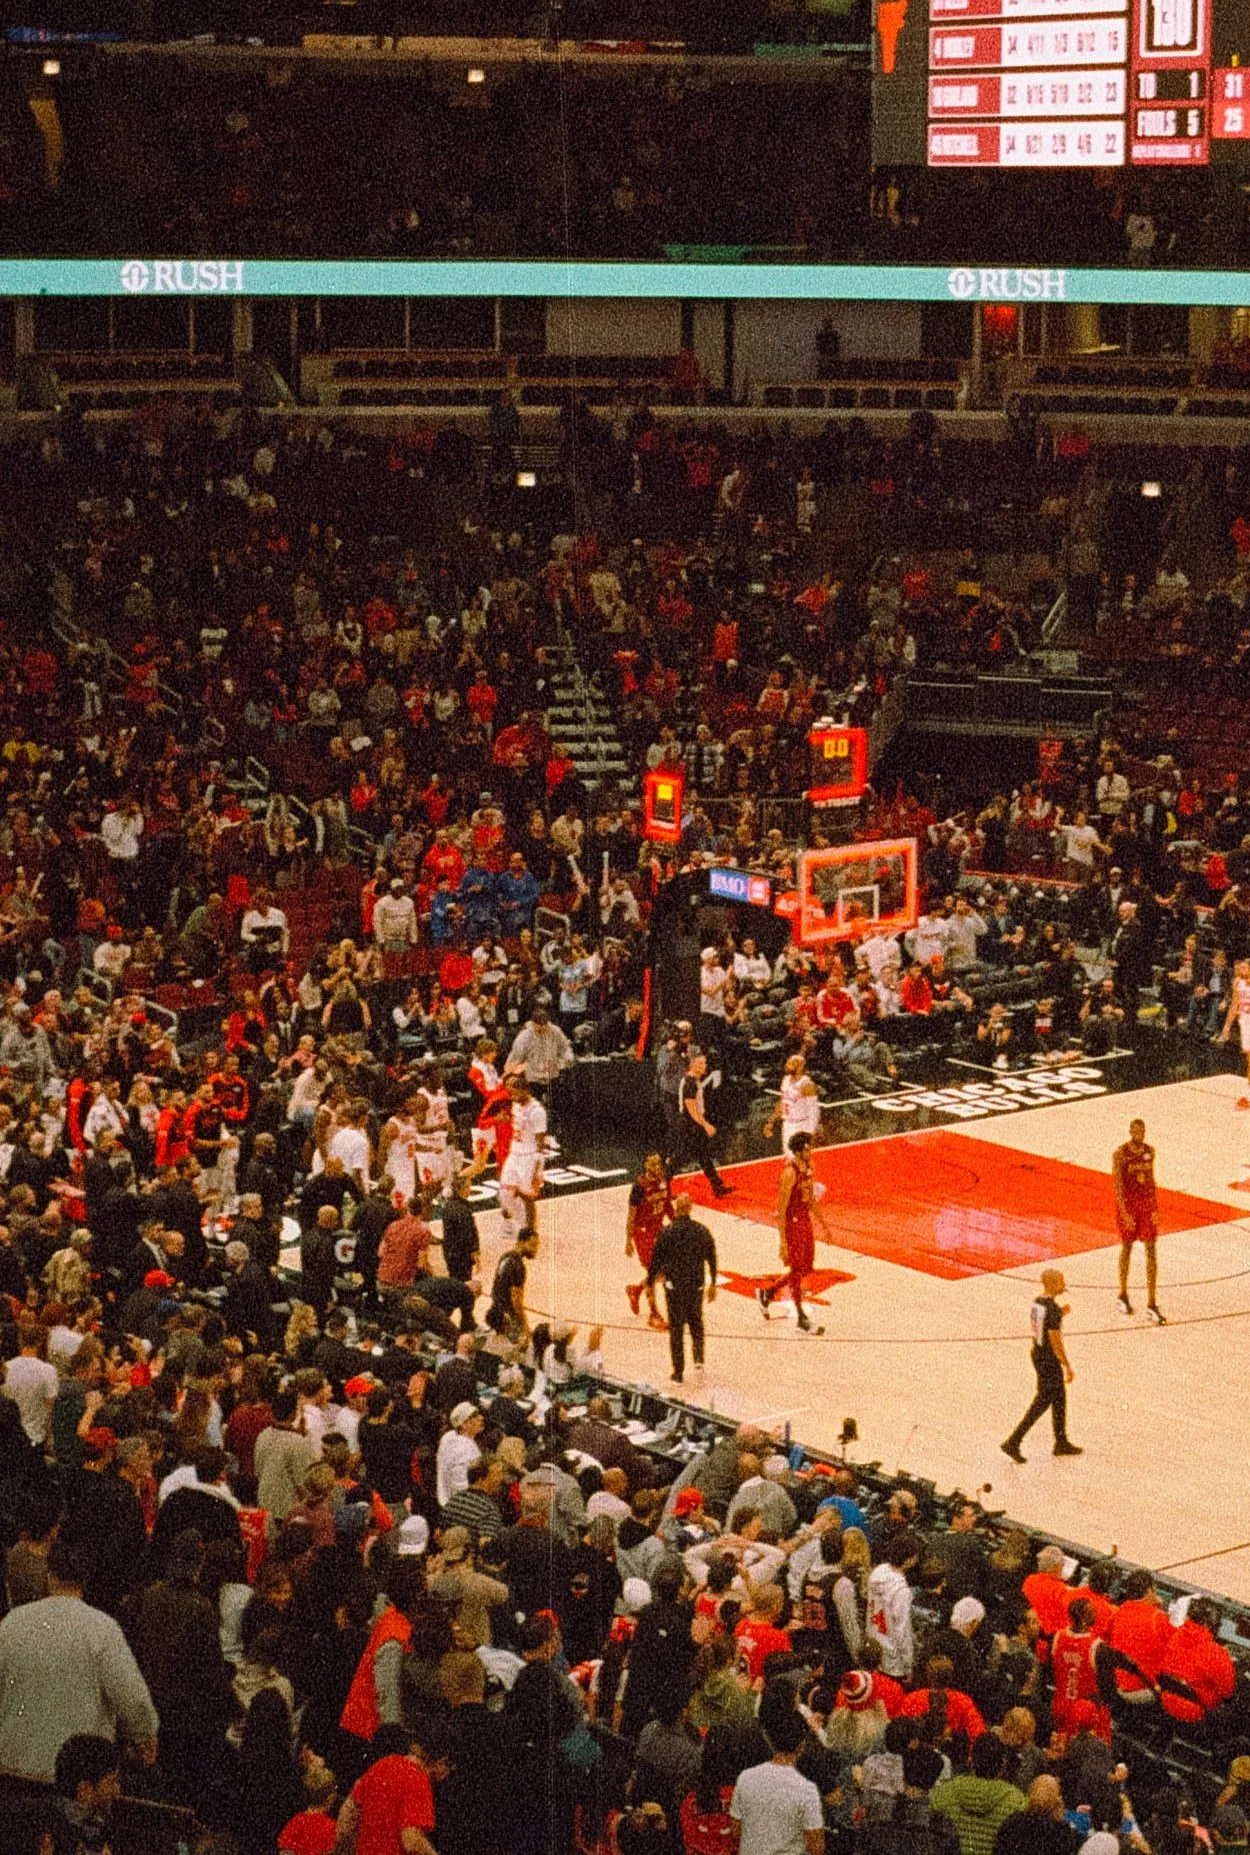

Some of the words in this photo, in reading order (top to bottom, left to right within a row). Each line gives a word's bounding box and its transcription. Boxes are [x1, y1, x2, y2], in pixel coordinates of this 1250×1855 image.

[1188, 72, 1199, 98] 1
[1224, 73, 1243, 98] 31
[1137, 110, 1176, 137] FOULS
[1186, 109, 1200, 136] 5
[1223, 107, 1244, 133] 25
[152, 261, 246, 291] RUSH
[979, 269, 1066, 298] RUSH
[710, 869, 746, 891] BMO
[872, 1067, 1103, 1112] CHICAGO
[934, 1081, 1107, 1117] BULLS
